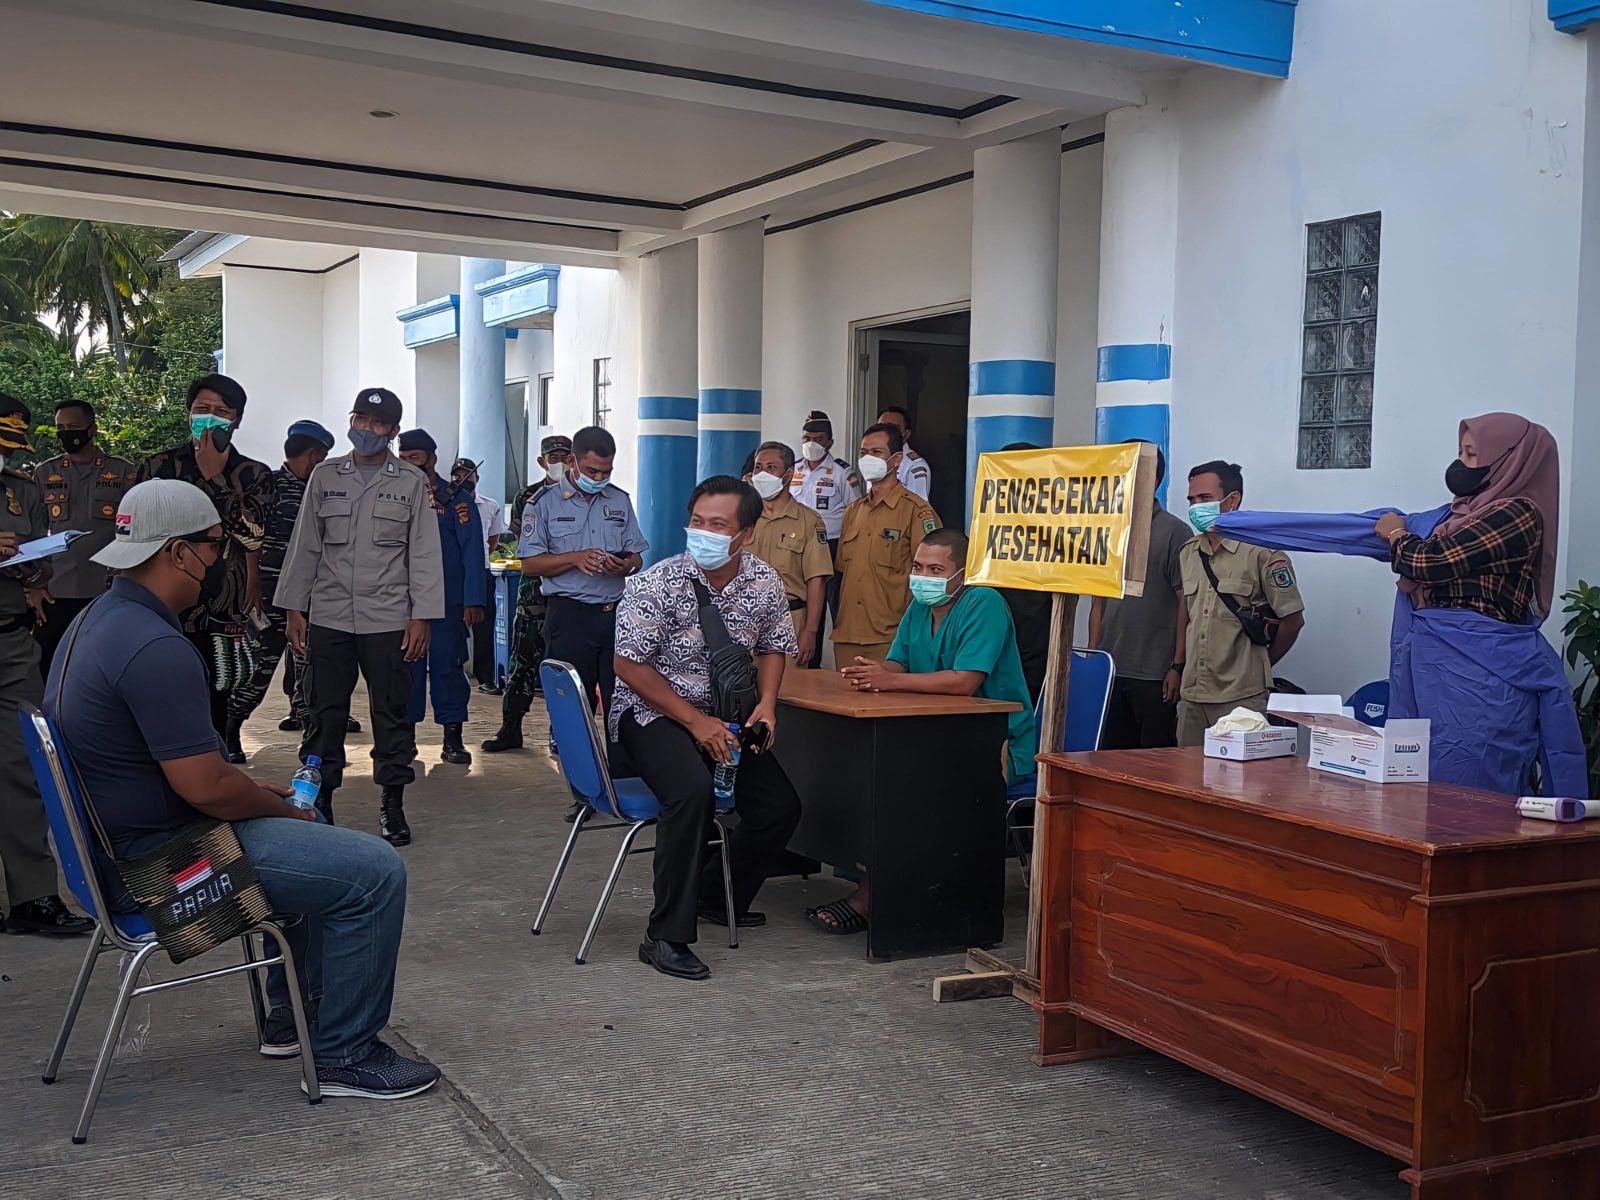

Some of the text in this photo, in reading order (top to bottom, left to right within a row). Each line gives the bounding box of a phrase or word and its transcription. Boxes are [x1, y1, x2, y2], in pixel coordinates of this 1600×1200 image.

[95, 481, 121, 489] POLRI
[378, 492, 411, 504] POLRI
[979, 475, 1127, 514] PENGECEKAN
[987, 524, 1110, 566] KESEHATAN
[171, 873, 233, 923] PAPUA
